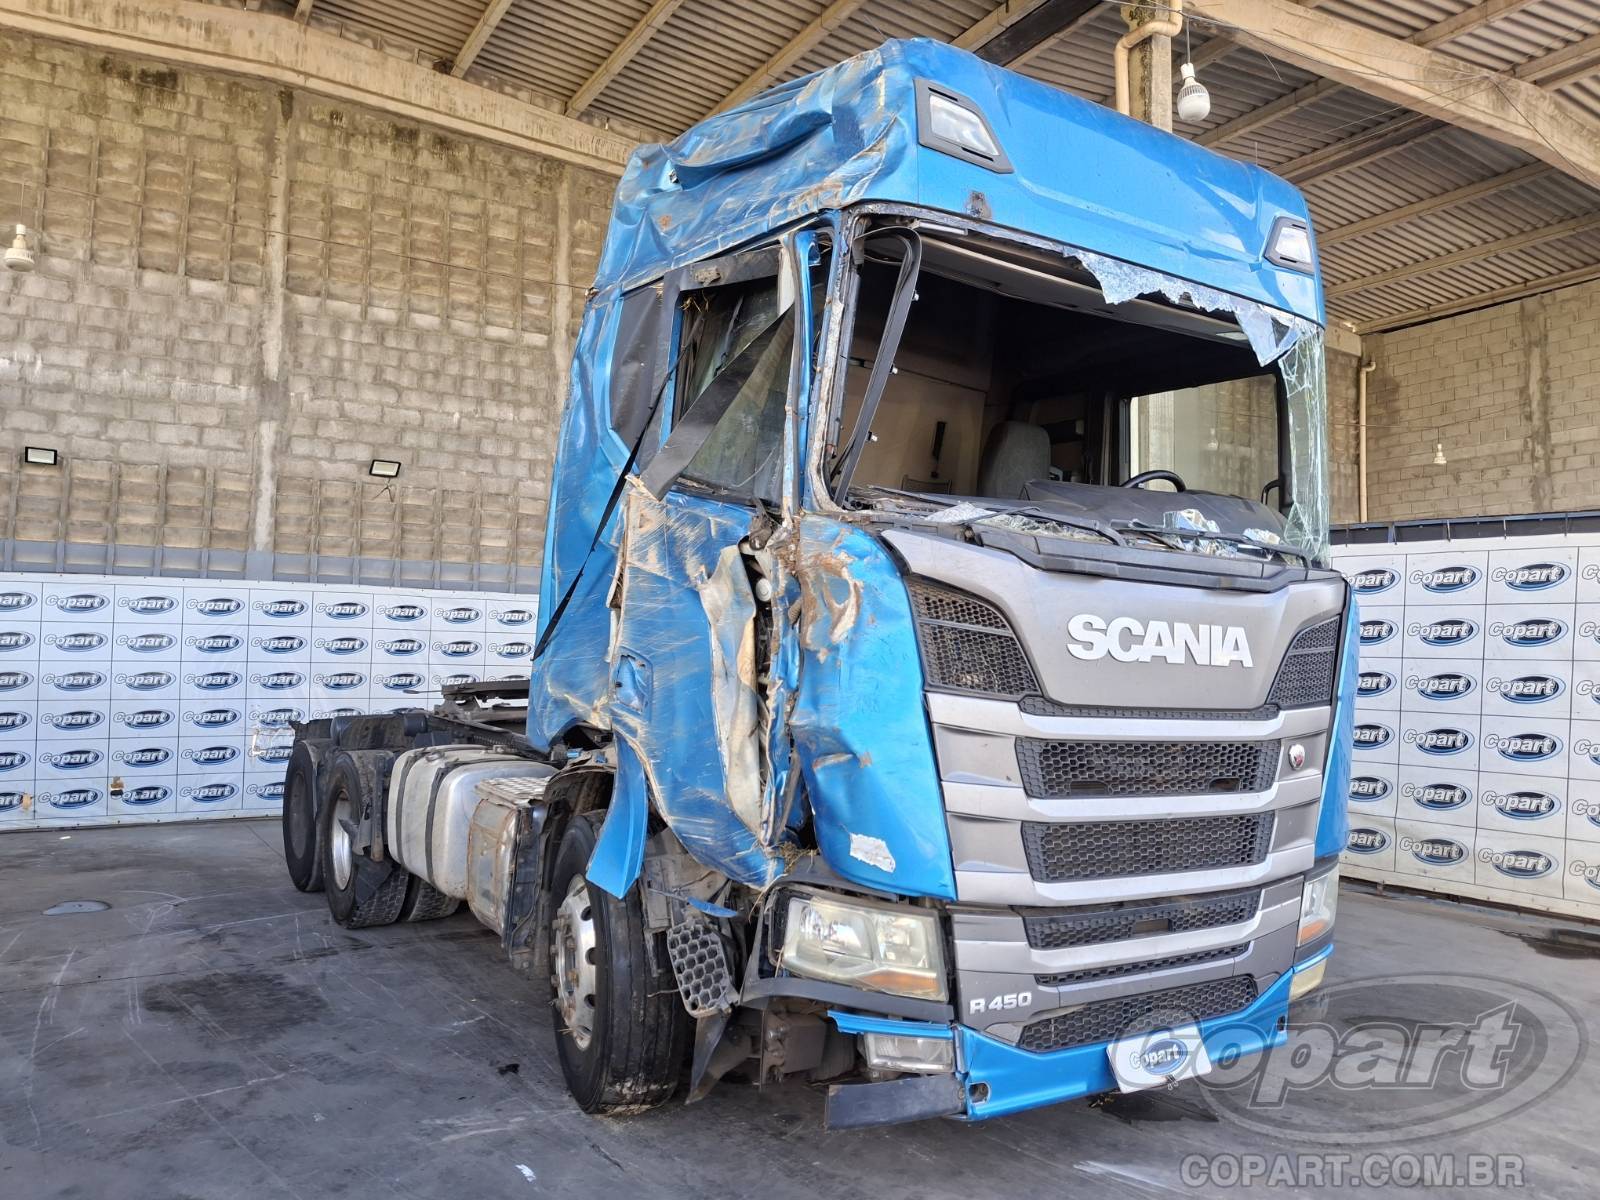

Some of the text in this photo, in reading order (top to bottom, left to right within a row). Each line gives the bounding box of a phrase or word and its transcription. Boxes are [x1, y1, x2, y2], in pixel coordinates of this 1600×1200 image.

[1343, 571, 1392, 586] opart
[1409, 569, 1473, 586] Copart
[1491, 566, 1562, 584] Copart
[46, 594, 100, 608] Copart
[118, 596, 169, 609] Copart
[186, 599, 236, 611] Copart
[252, 601, 301, 614] Copart
[315, 603, 362, 614] Copart
[376, 606, 421, 617] Copart
[434, 608, 476, 620] Copart
[489, 609, 529, 621] Copart
[1407, 622, 1470, 638] Copart
[1488, 621, 1559, 640] Copart
[44, 633, 98, 647] Copart
[116, 635, 168, 647] Copart
[185, 636, 236, 648] Copart
[251, 638, 299, 650] Copart
[315, 638, 361, 650] Copart
[375, 640, 420, 652] Copart
[1067, 613, 1254, 668] SCANIA
[433, 641, 476, 653] Copart
[488, 643, 528, 654] Copart
[43, 673, 98, 686] Copart
[114, 673, 167, 686] Copart
[184, 673, 234, 686] Copart
[250, 674, 299, 686] Copart
[313, 674, 360, 686] Copart
[374, 674, 419, 686] Copart
[1405, 675, 1468, 693] Copart
[1486, 677, 1556, 695] Copart
[41, 712, 97, 726] Copart
[113, 711, 166, 724] Copart
[183, 710, 234, 723] Copart
[249, 709, 299, 722] Copart
[1403, 729, 1465, 748] Copart
[1484, 734, 1553, 754] Copart
[39, 752, 95, 765] Copart
[112, 750, 165, 763] Copart
[181, 748, 232, 761] Copart
[38, 790, 93, 804] Copart
[112, 788, 164, 801] opart
[180, 785, 231, 798] Copart
[1401, 783, 1463, 803] Copart
[1481, 790, 1551, 811] Copart
[1399, 837, 1460, 857] Copart
[1478, 848, 1548, 870] Copart
[969, 991, 1032, 1015] R 450
[1129, 1043, 1180, 1071] Copart
